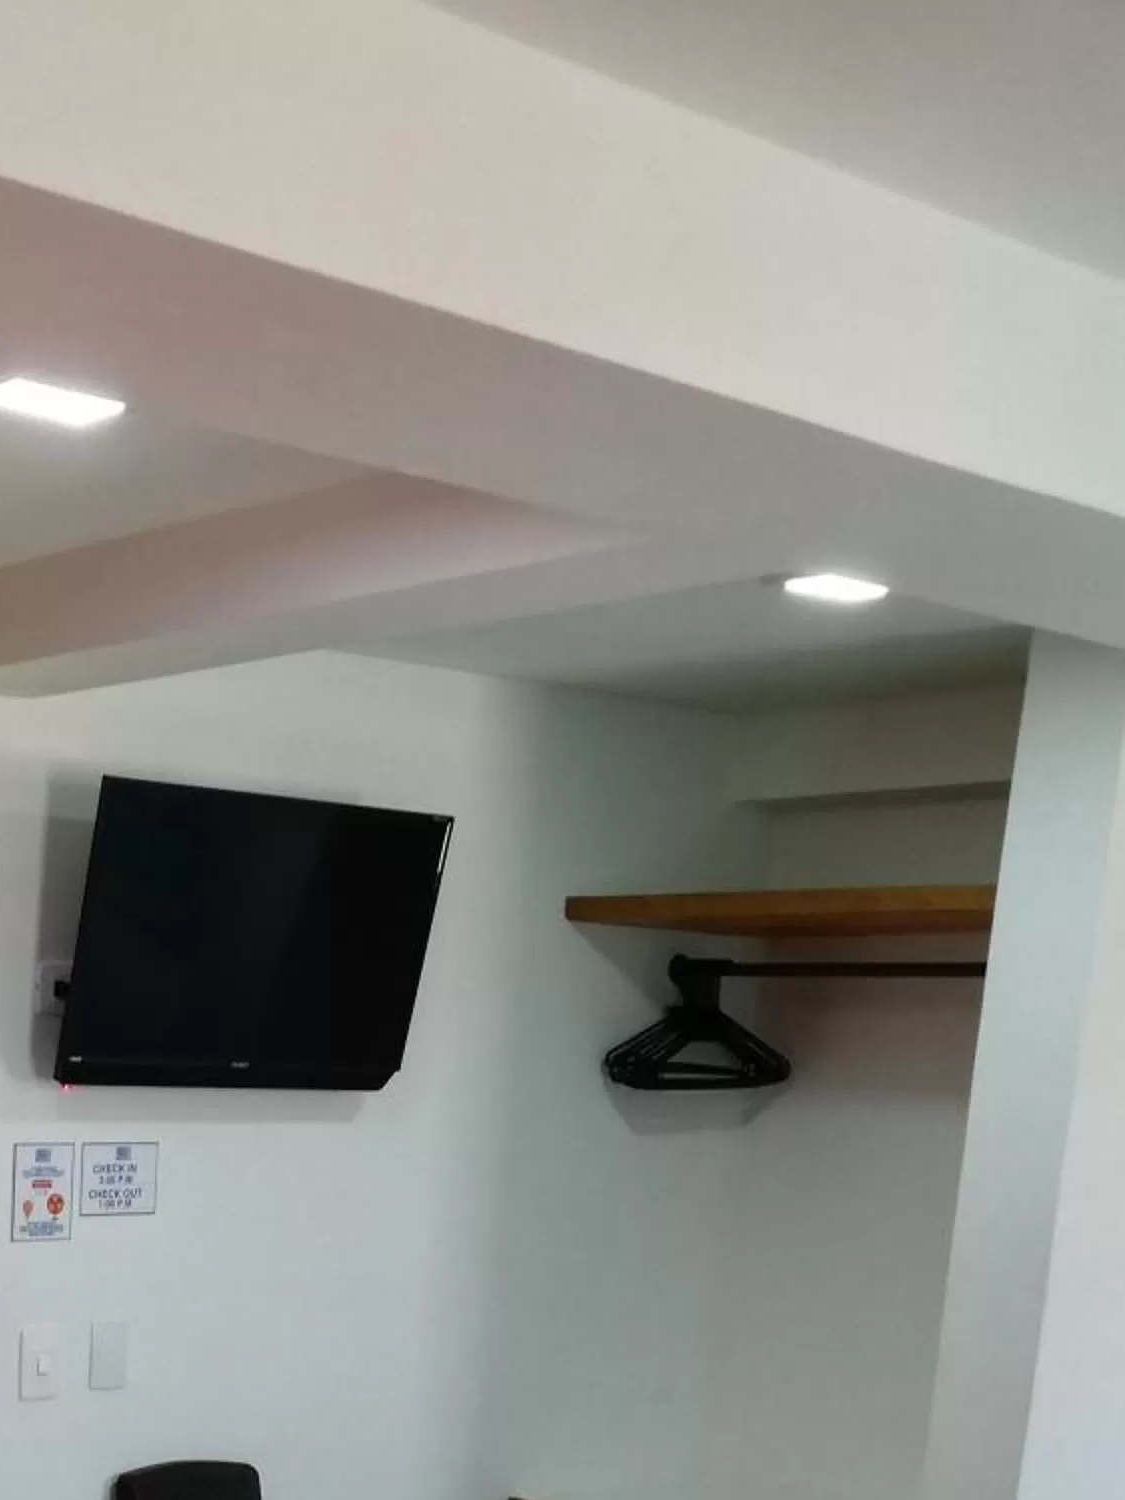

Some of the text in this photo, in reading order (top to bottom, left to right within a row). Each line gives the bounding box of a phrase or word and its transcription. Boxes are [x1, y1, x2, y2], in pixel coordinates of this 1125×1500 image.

[92, 1163, 125, 1173] CHECK
[88, 1187, 142, 1200] CHECK OUT
